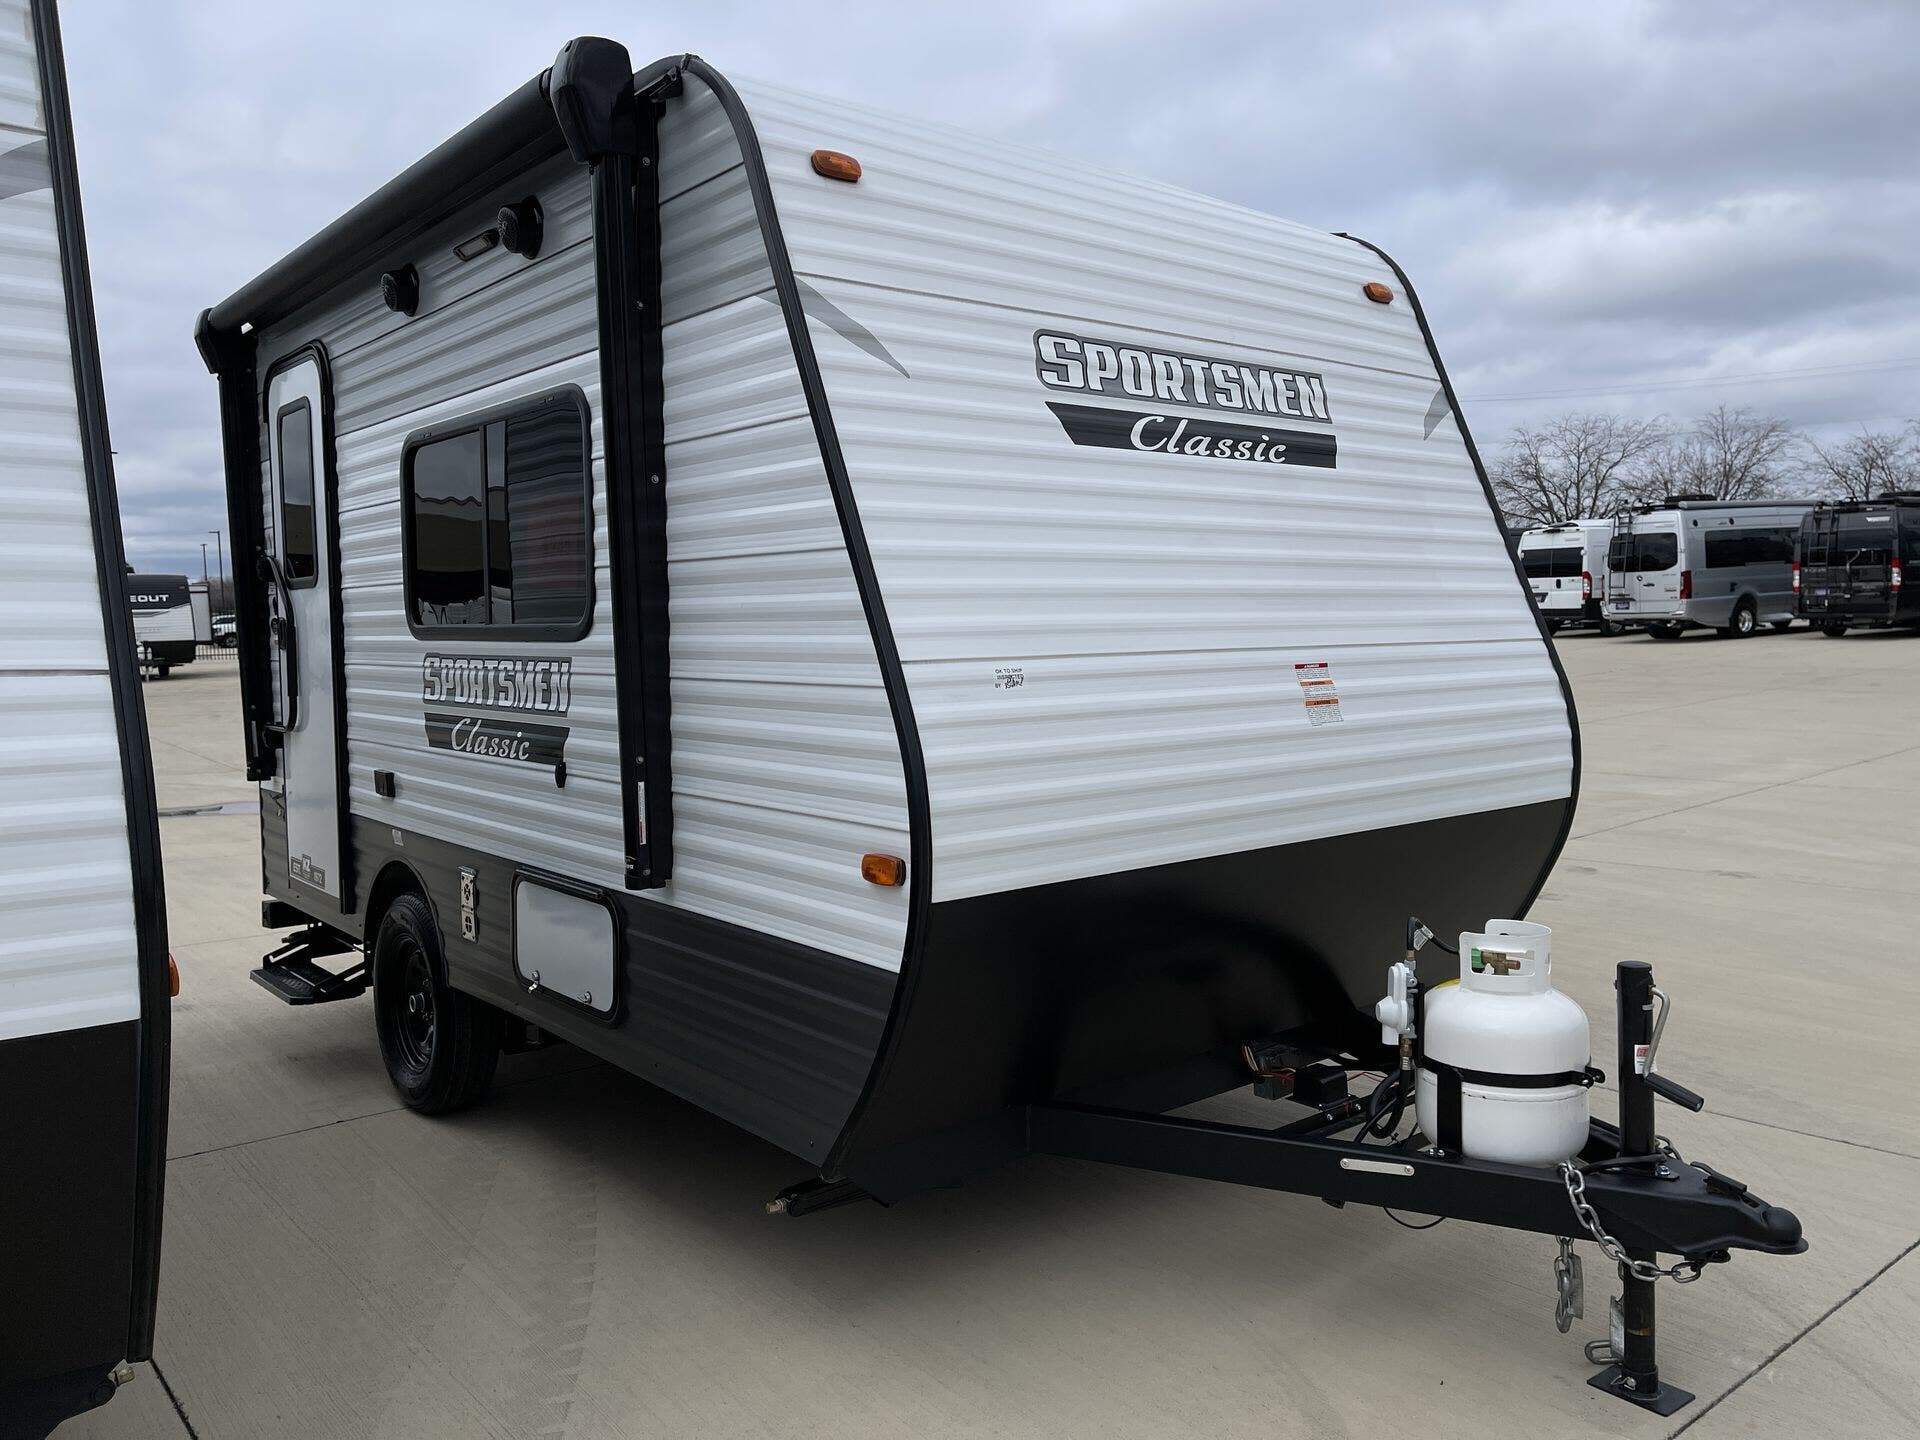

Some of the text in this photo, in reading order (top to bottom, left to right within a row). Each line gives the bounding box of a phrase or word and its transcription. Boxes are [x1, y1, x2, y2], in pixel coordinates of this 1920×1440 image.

[1037, 334, 1329, 420] SPORTSMEN
[1130, 415, 1287, 464] Classic
[423, 656, 571, 712] SPORTSMEN
[451, 717, 530, 761] Classic
